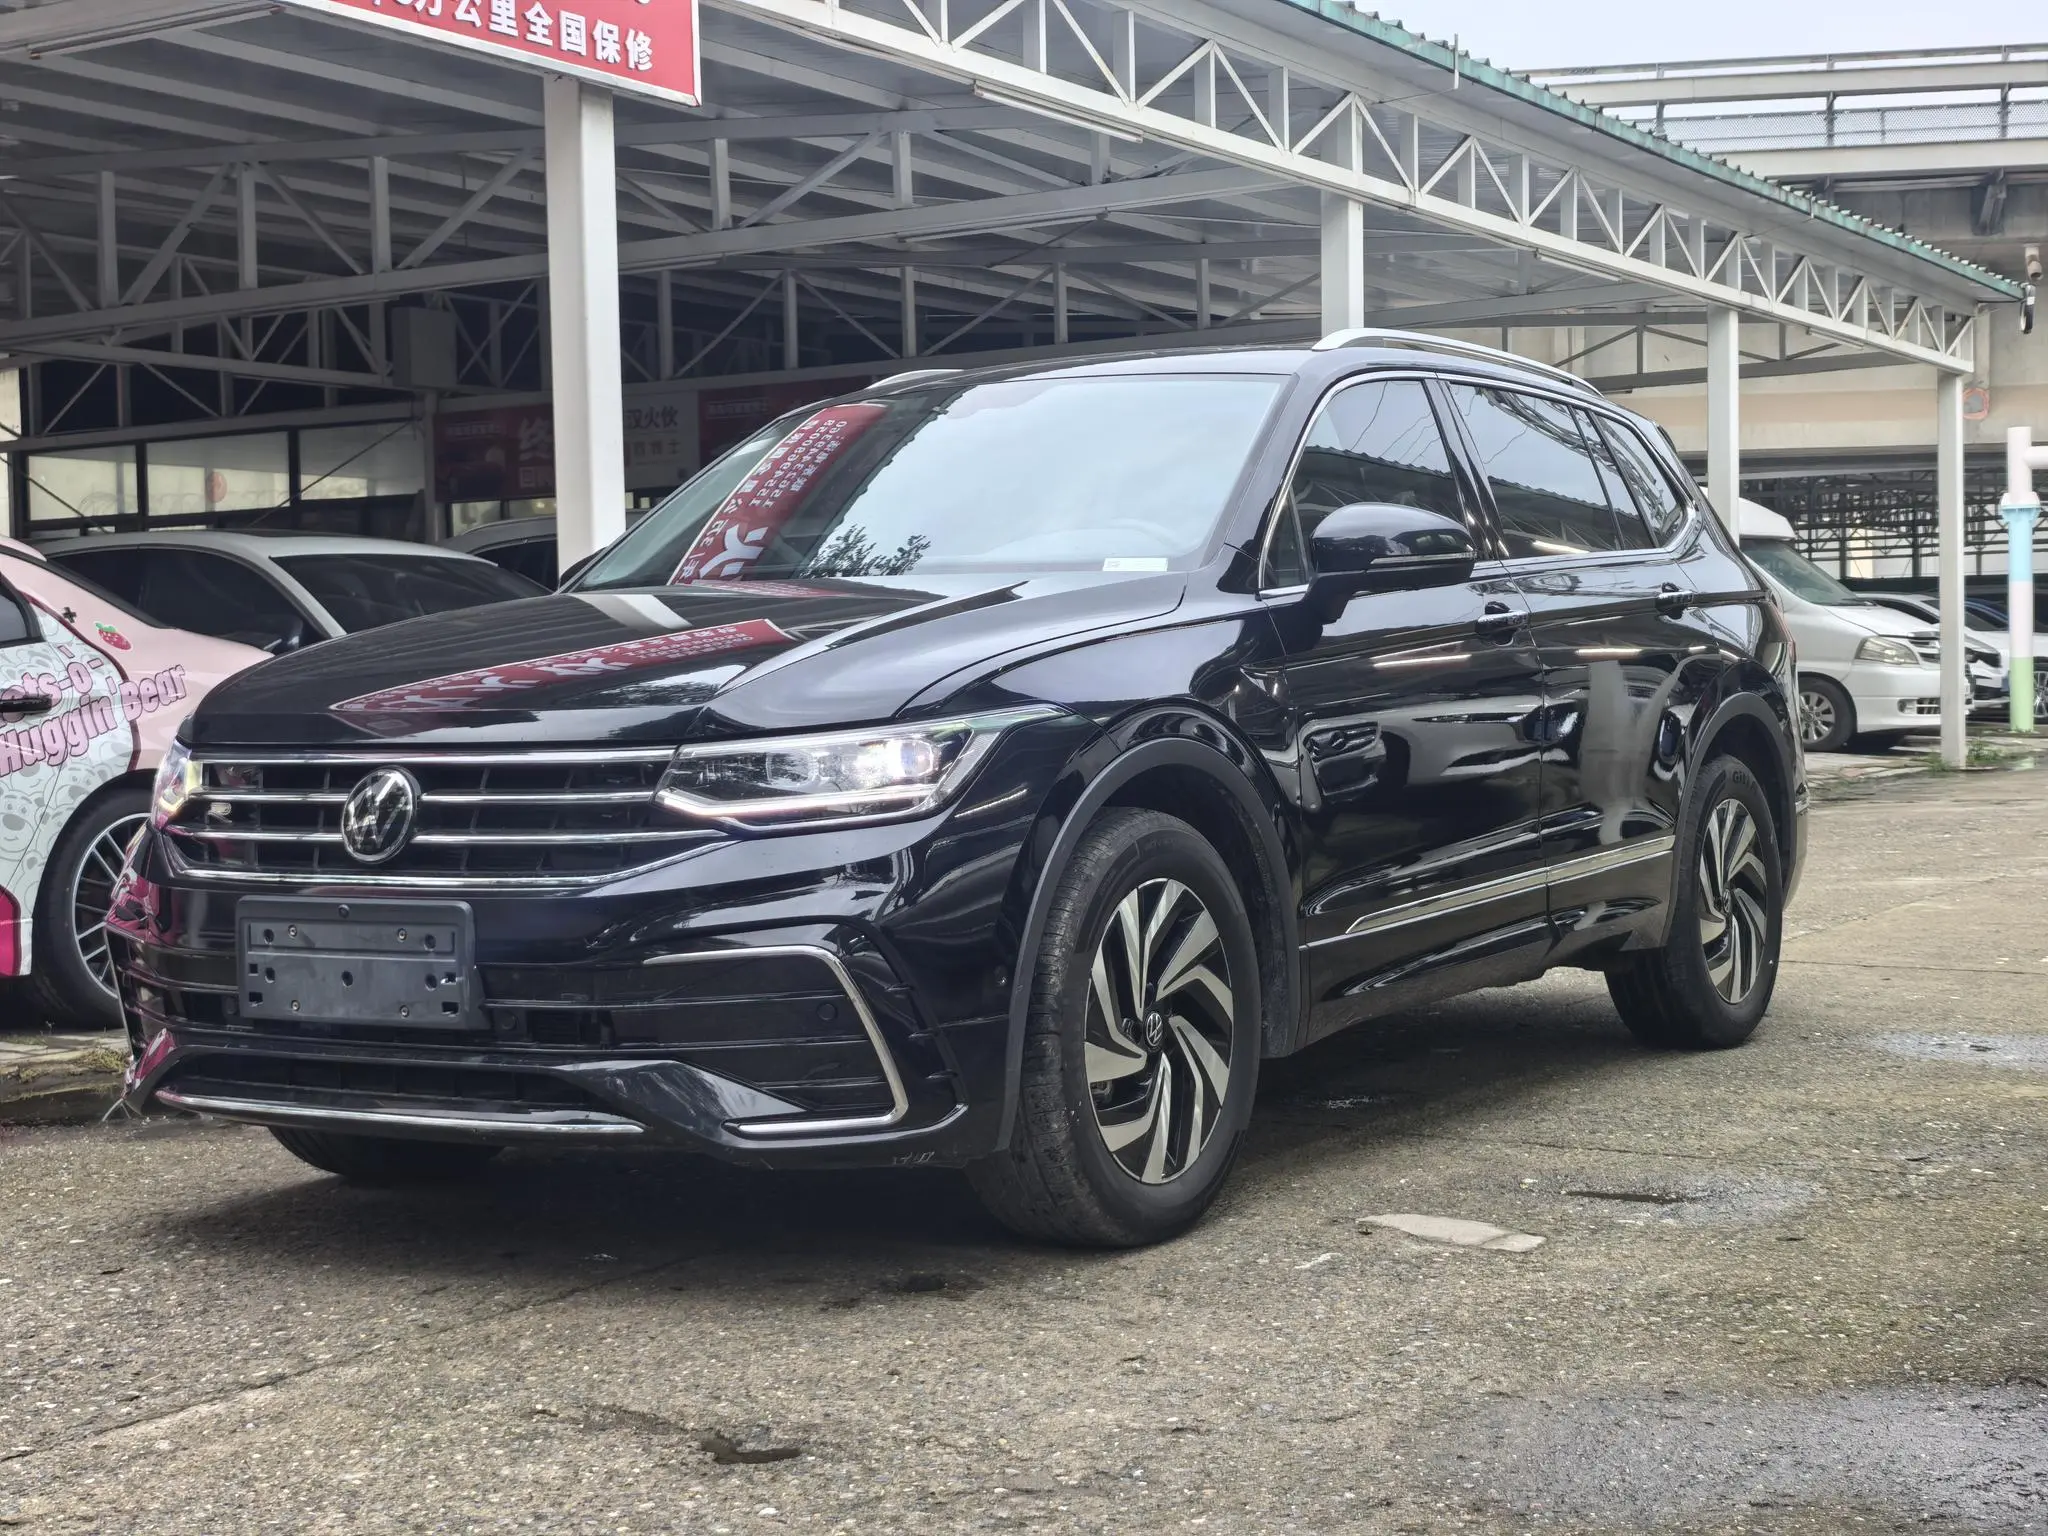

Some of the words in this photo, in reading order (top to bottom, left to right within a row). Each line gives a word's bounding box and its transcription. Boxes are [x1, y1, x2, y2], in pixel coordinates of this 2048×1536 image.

[373, 0, 654, 71] 公里全国保修
[119, 664, 187, 722] Bear
